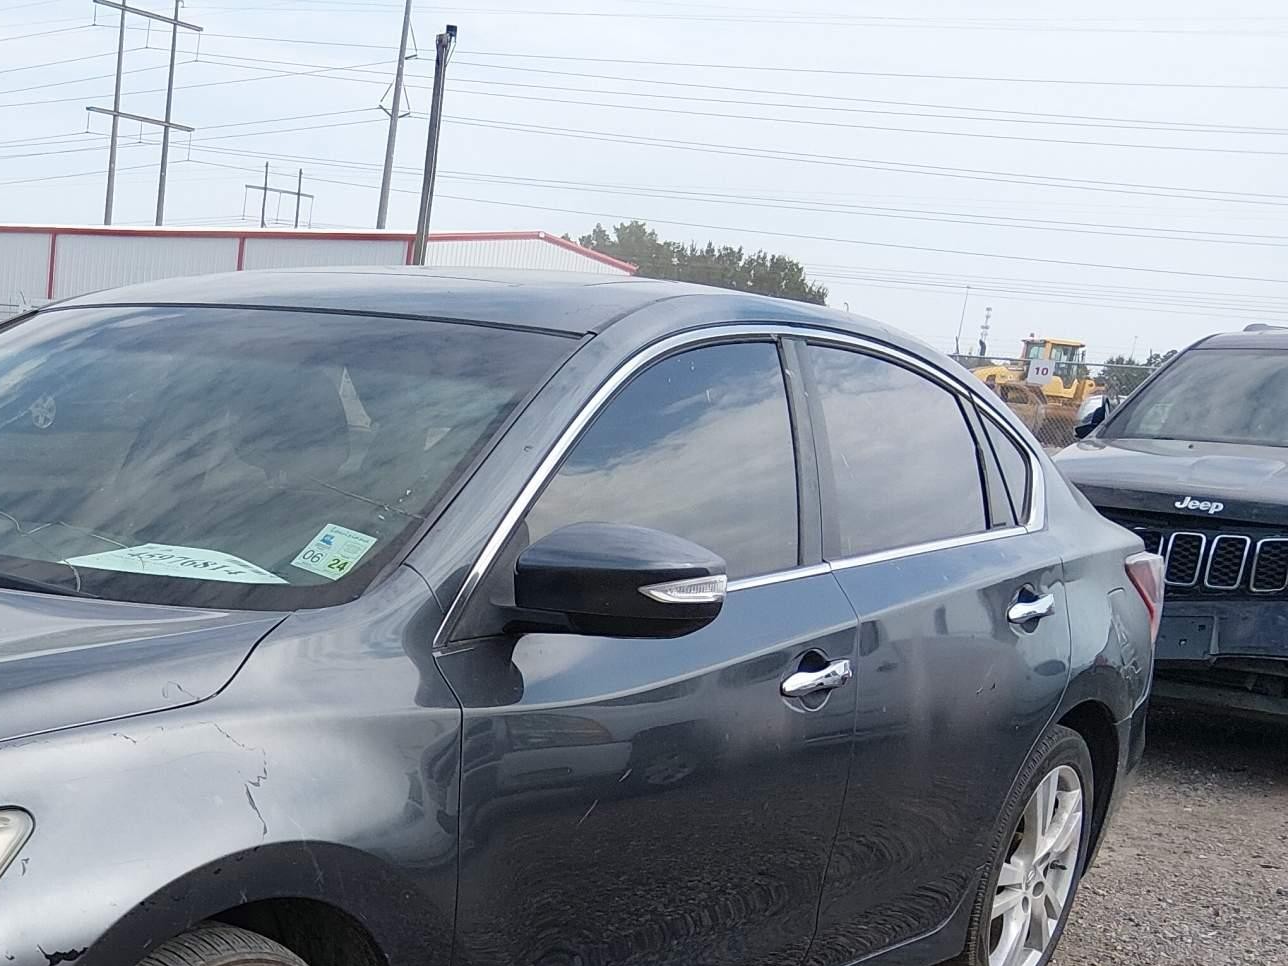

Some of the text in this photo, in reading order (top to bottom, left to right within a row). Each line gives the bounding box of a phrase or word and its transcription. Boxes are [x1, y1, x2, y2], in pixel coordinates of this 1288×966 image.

[1034, 367, 1049, 376] 10
[1174, 497, 1224, 514] Jeep
[302, 549, 324, 563] 06
[327, 558, 349, 571] 24
